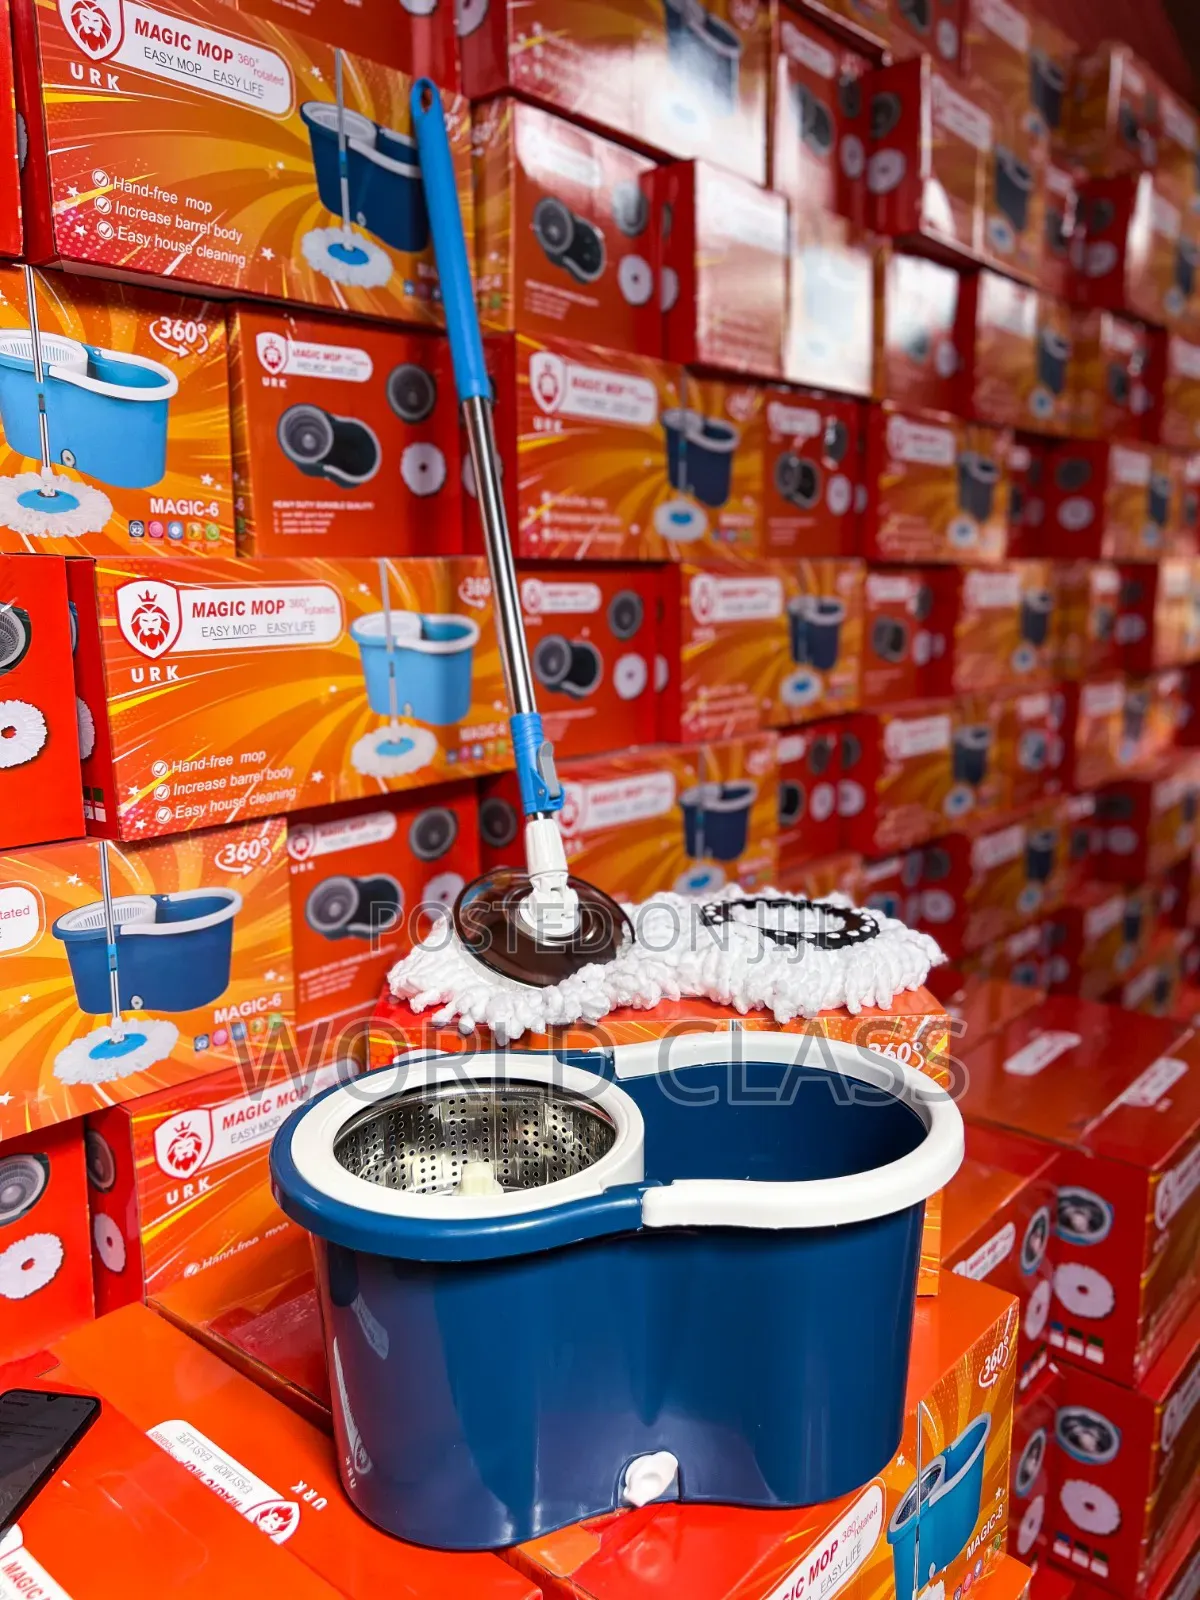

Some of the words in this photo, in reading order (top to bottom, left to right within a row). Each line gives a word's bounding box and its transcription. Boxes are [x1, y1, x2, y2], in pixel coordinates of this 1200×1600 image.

[134, 18, 191, 51] MAGIC
[197, 39, 233, 64] MOP
[69, 62, 121, 91] URK
[144, 46, 173, 66] EASY
[177, 57, 202, 75] MOP
[213, 69, 241, 88] EASY
[243, 80, 264, 96] LIFE
[253, 68, 285, 86] rotated
[113, 176, 178, 204] Hand-free
[185, 196, 213, 214] mop
[115, 200, 172, 226] Increase
[175, 214, 210, 234] barrel
[213, 223, 243, 245] body
[117, 226, 151, 247] Easy
[154, 234, 193, 254] house
[196, 244, 246, 268] cleaning
[159, 316, 207, 343] 360°
[149, 497, 219, 517] MAGIC-6
[192, 601, 246, 618] MAGIC
[251, 599, 285, 616] MOP
[201, 625, 230, 638] EASY
[233, 624, 256, 635] MOP
[267, 622, 293, 634] EASY
[294, 621, 316, 632] LIFE
[130, 665, 180, 683] URK
[172, 754, 233, 774] Hand-free
[240, 751, 266, 764] mop
[173, 778, 227, 796] Increase
[230, 769, 264, 787] barrel
[266, 765, 294, 781] body
[175, 803, 206, 819] Easy
[209, 797, 246, 813] house
[249, 786, 296, 805] cleaning
[223, 837, 270, 865] 360°
[214, 992, 282, 1024] MAGIC-6
[222, 1099, 272, 1131] MAGIC
[277, 1085, 309, 1108] MOP
[230, 1127, 258, 1144] EASY
[259, 1116, 281, 1132] MOP
[166, 1176, 213, 1205] URK
[175, 1432, 195, 1448] LIFE
[192, 1446, 213, 1463] EASY
[213, 1463, 233, 1482] MOP
[230, 1478, 253, 1495] EASY
[290, 1480, 328, 1511] URK
[808, 1540, 839, 1586] MOP
[820, 1559, 844, 1594] EASY
[844, 1541, 862, 1568] LIFE
[1, 1560, 44, 1600] MAGIC
